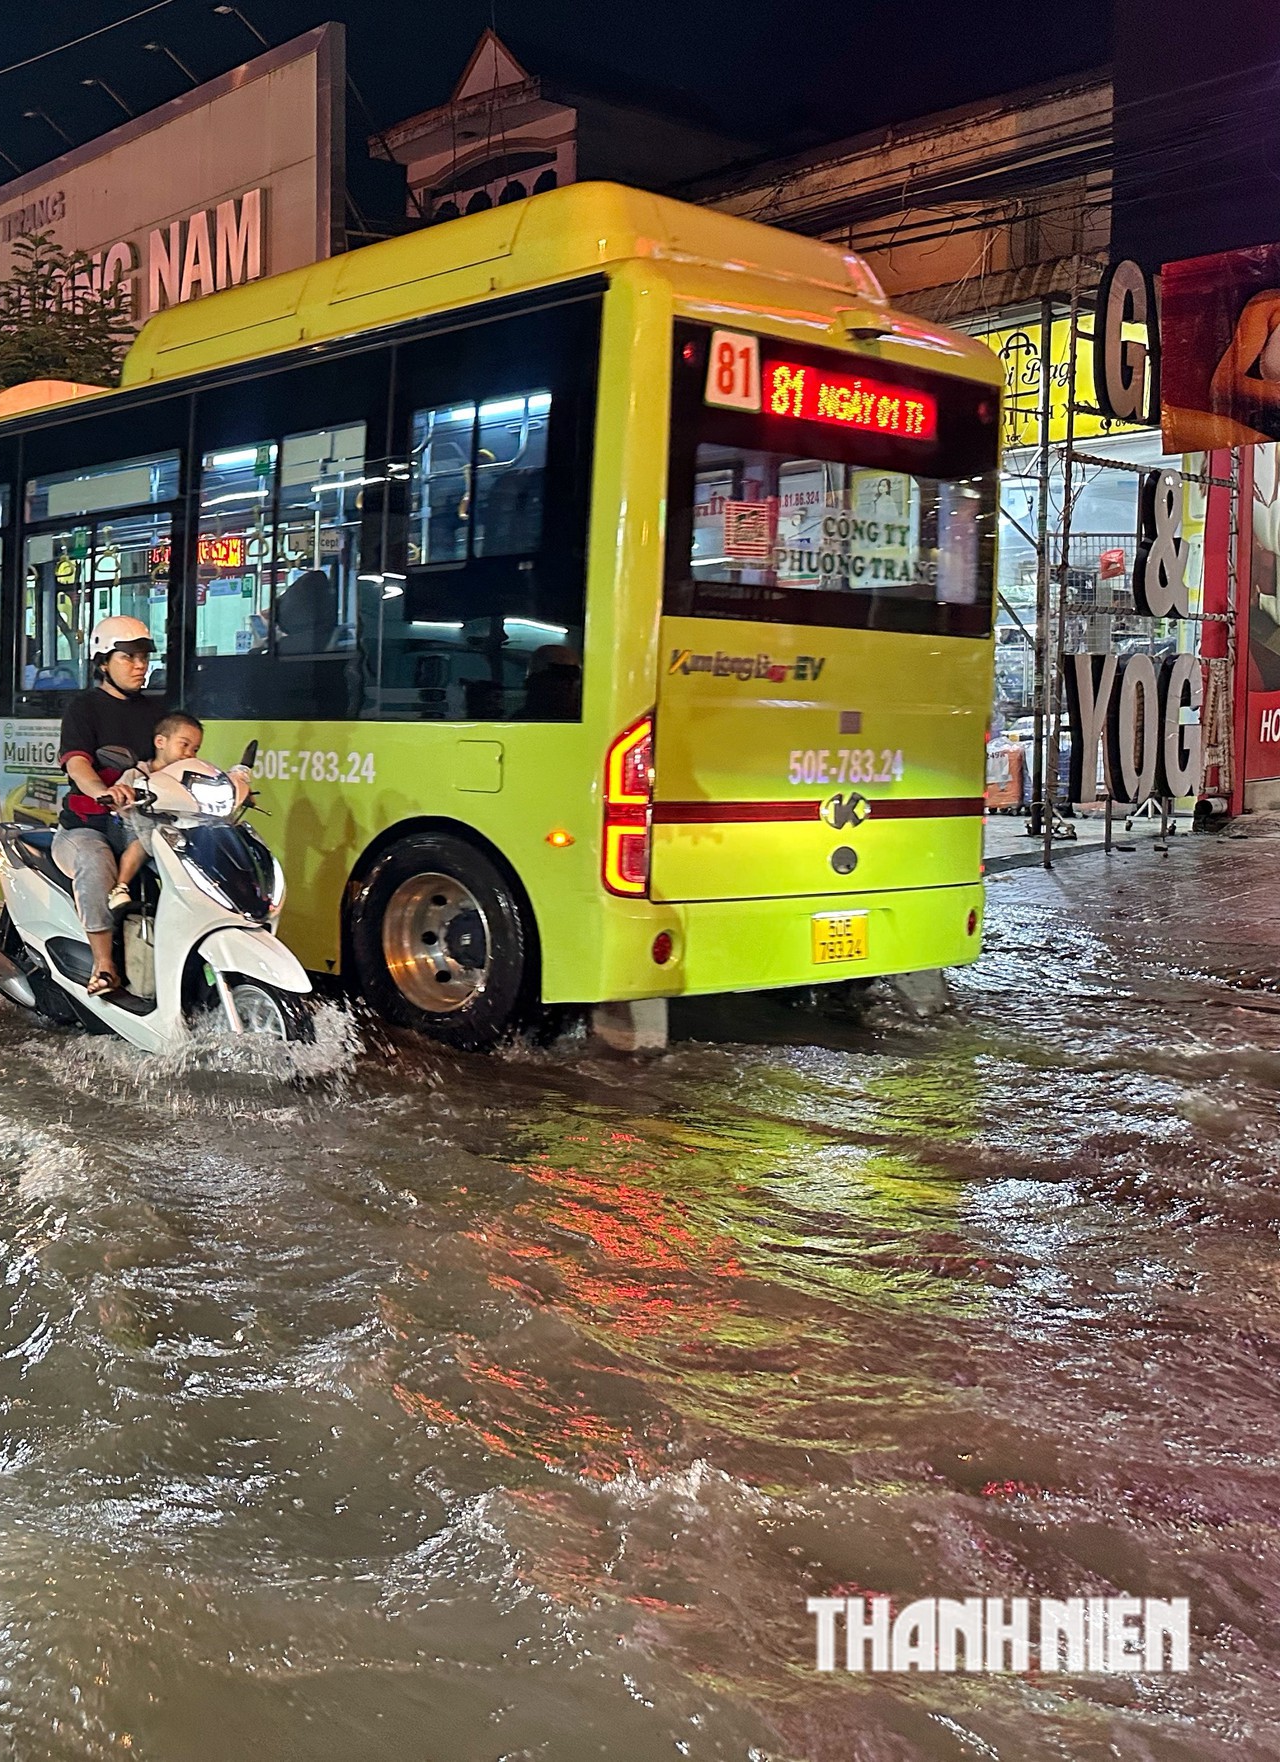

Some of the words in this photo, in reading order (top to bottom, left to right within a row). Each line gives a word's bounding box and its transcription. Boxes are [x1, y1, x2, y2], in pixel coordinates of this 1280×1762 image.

[149, 188, 261, 313] NAM
[1104, 260, 1161, 421] G
[717, 342, 751, 397] 81
[771, 366, 806, 417] 81
[822, 511, 879, 543] CÔNG
[884, 523, 910, 546] TY
[1143, 469, 1189, 618] &
[870, 556, 938, 585] TRANG
[4, 741, 60, 763] MultiG
[253, 750, 376, 784] 50E-783.24
[788, 749, 903, 785] 50E-783.24
